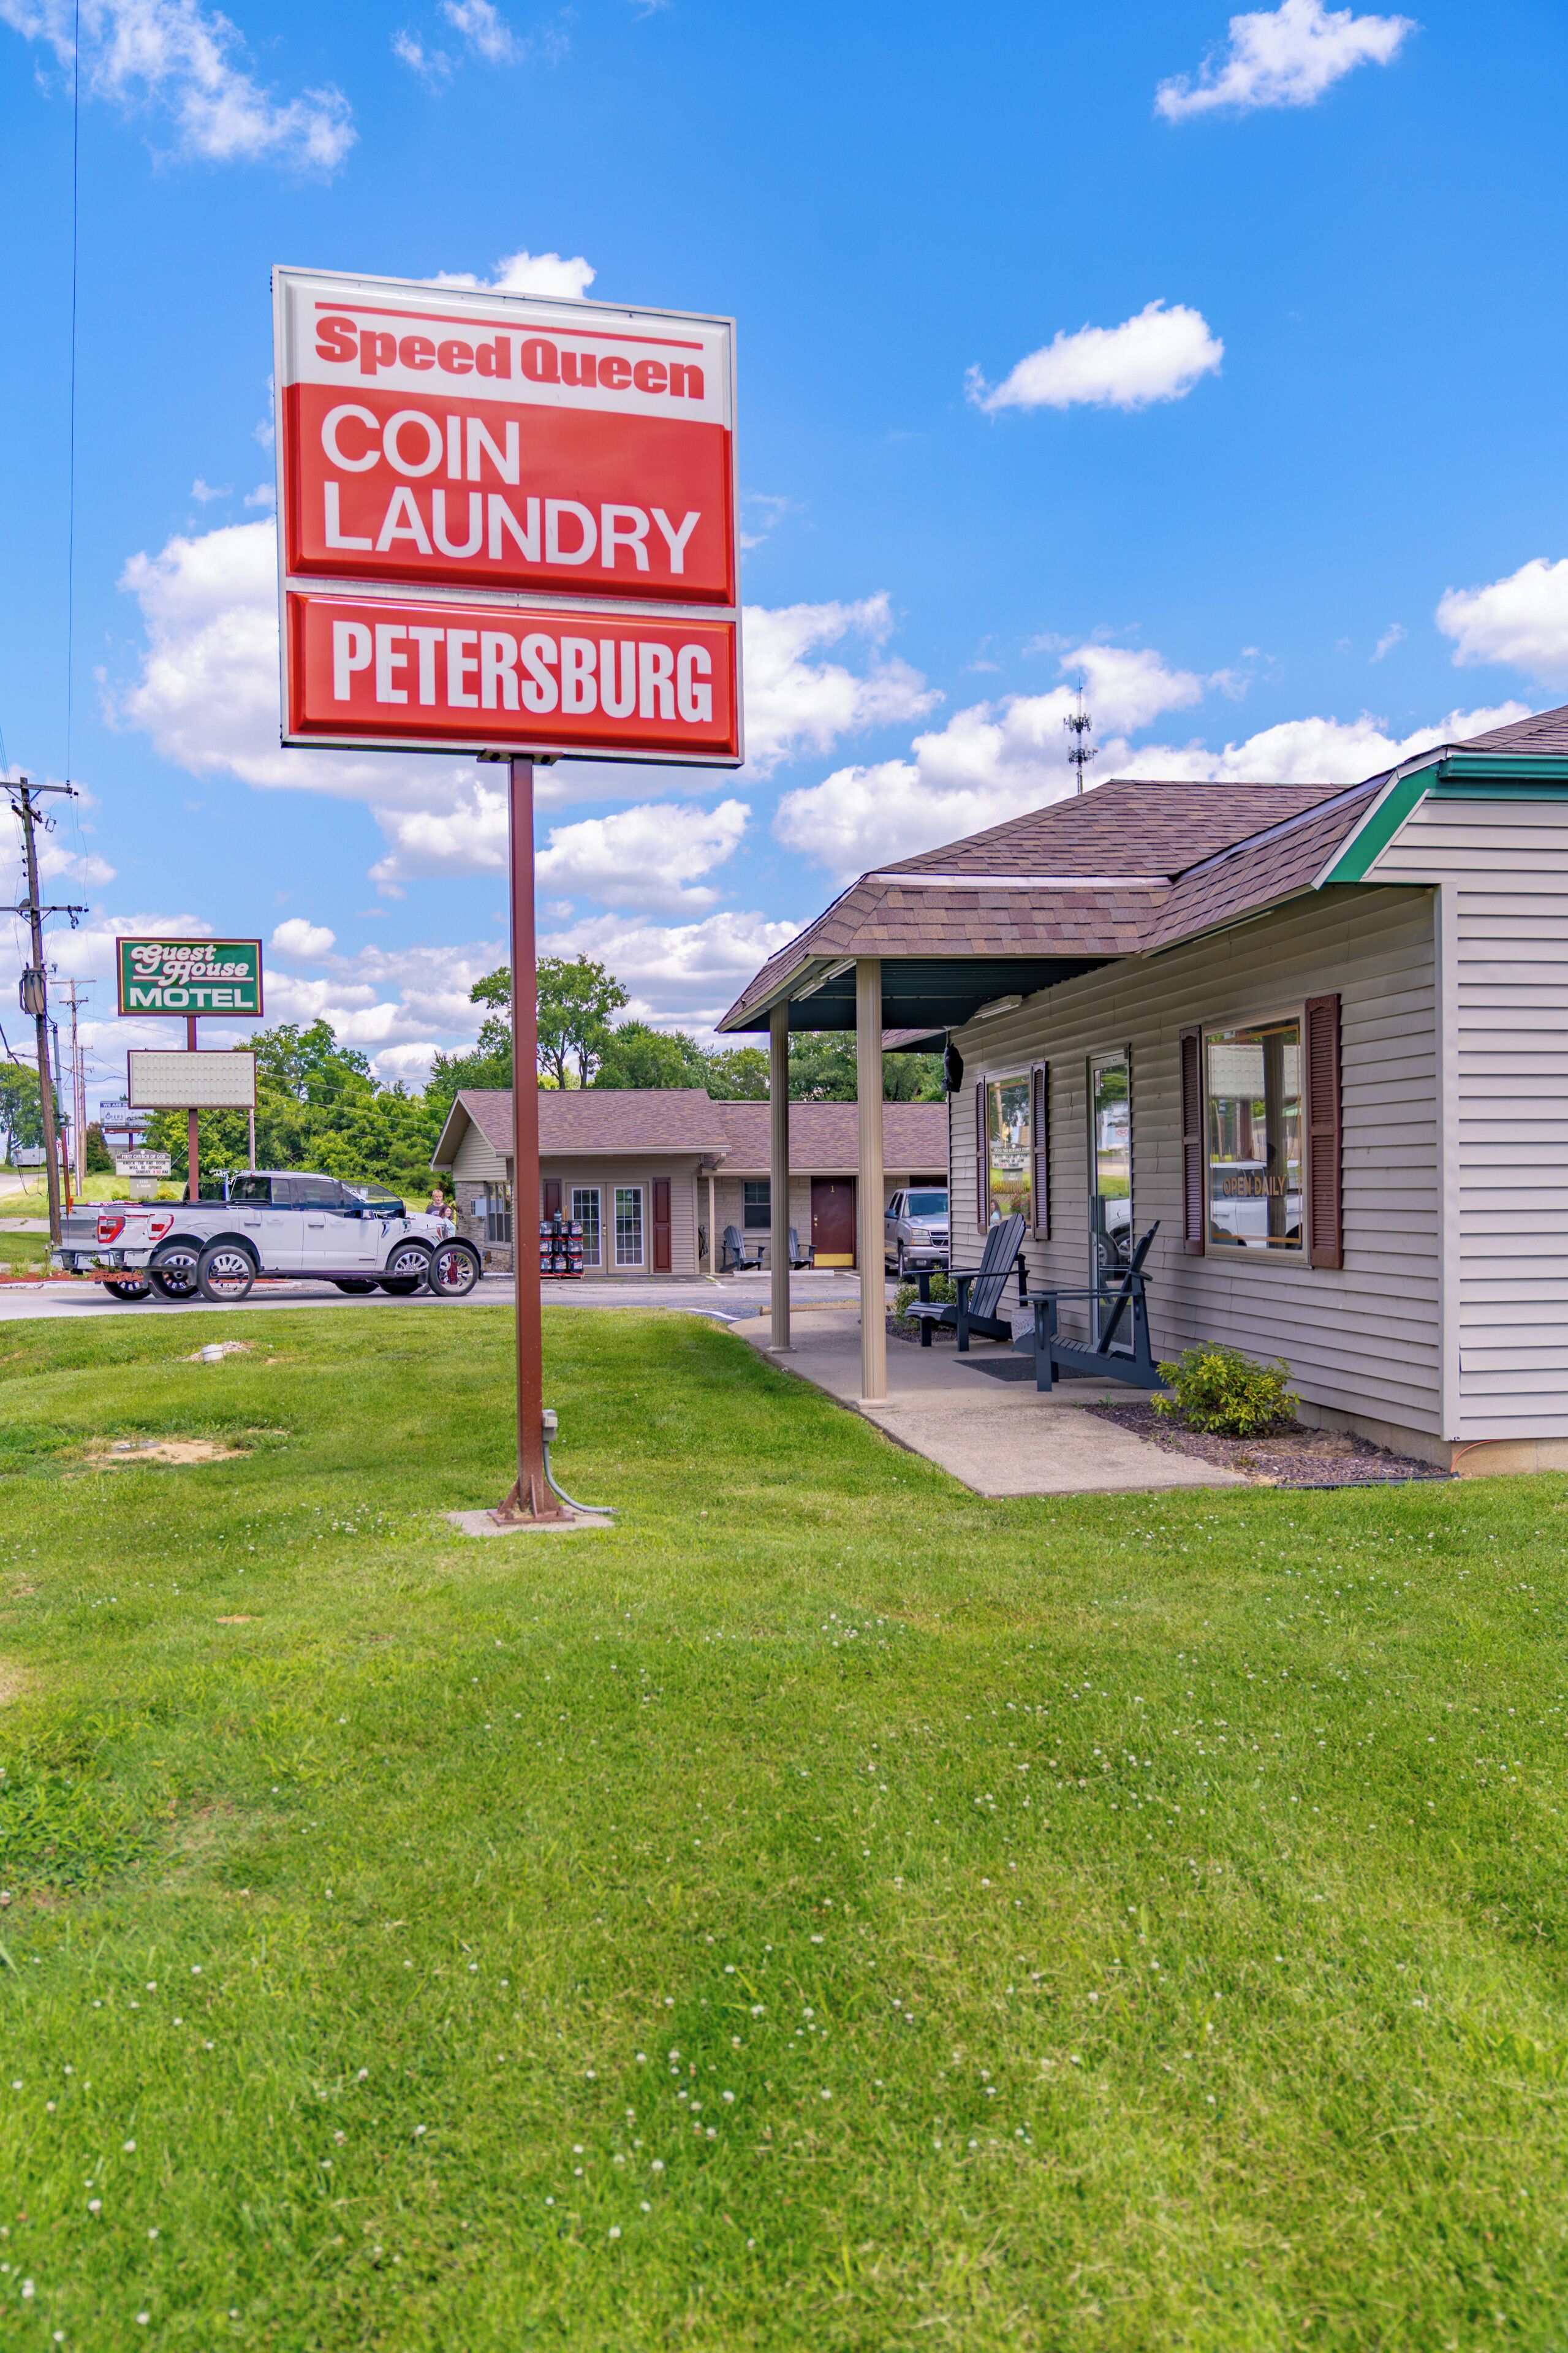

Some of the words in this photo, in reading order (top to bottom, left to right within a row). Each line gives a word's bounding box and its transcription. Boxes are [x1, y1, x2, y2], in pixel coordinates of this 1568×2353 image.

[315, 316, 511, 380] Speed
[521, 338, 704, 400] Queen
[320, 404, 520, 485] COIN
[324, 481, 701, 574] LAUNDRY
[333, 620, 713, 722] PETERSBURG
[131, 944, 217, 974] Guest
[157, 960, 249, 987] House
[129, 987, 254, 1007] MOTEL
[1222, 1176, 1252, 1197] OPEN
[1254, 1176, 1286, 1197] DAILY
